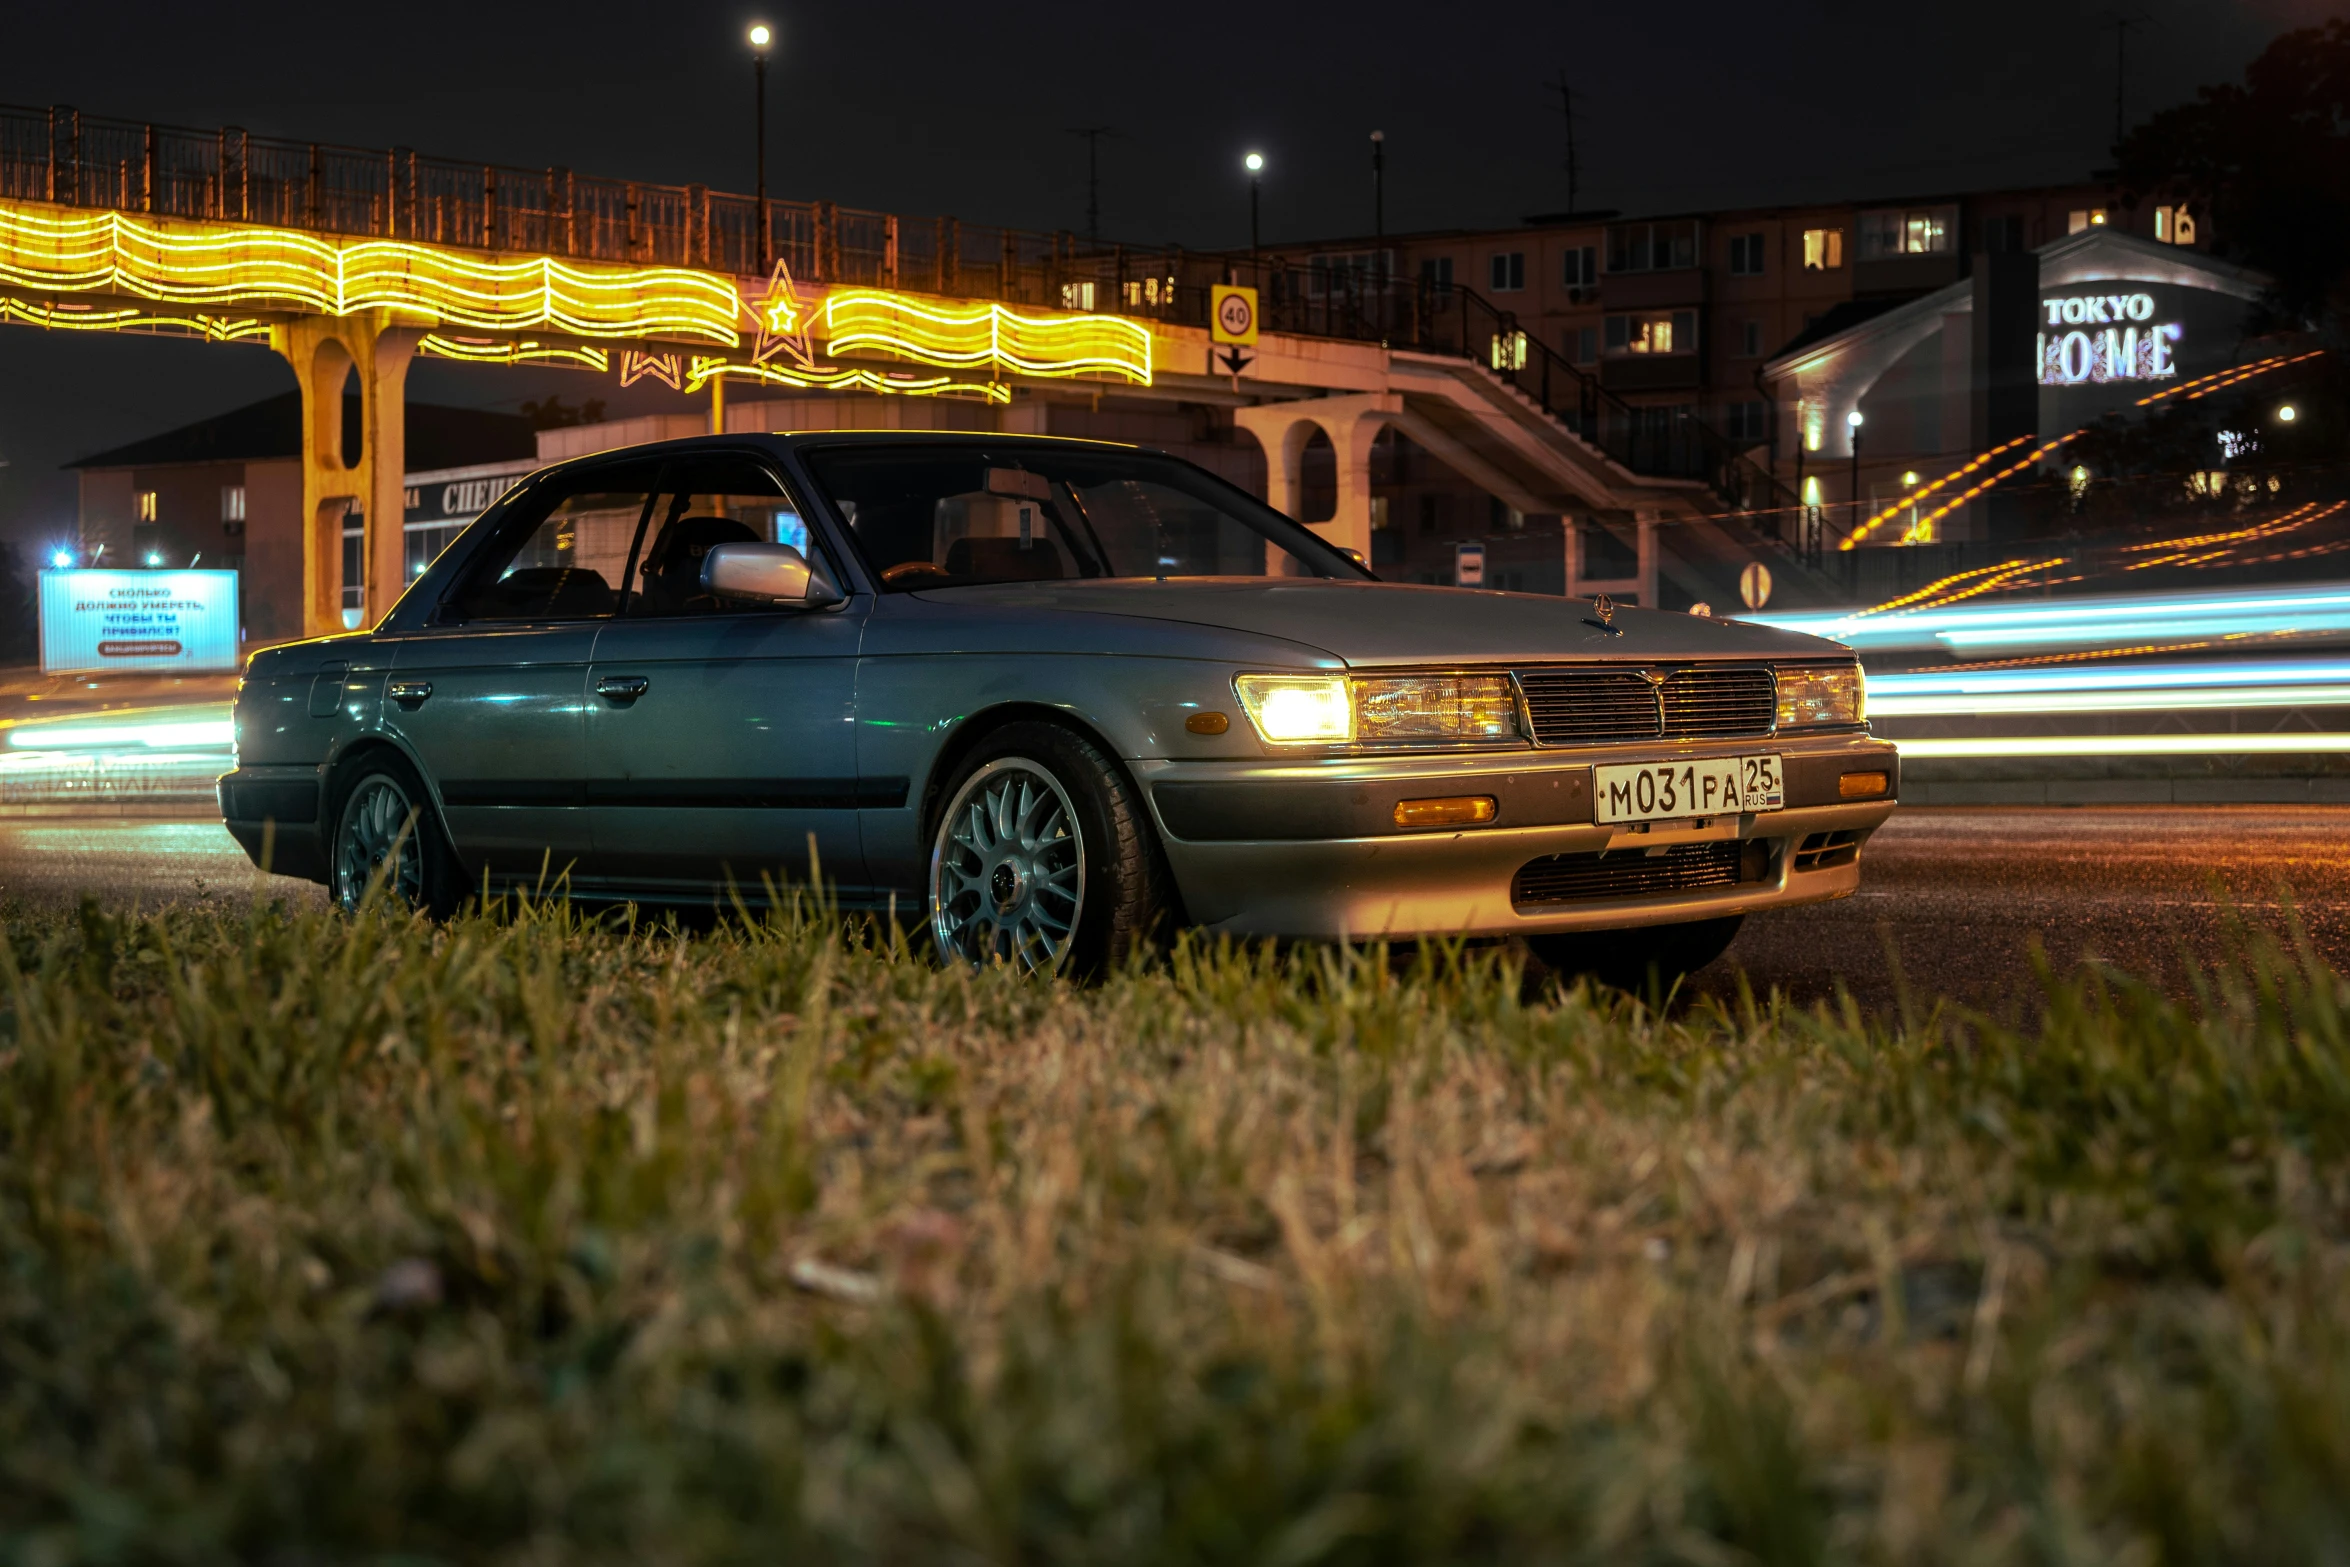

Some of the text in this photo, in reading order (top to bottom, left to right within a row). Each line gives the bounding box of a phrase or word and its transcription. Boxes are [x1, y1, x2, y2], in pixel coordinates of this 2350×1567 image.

[1224, 307, 1247, 325] 40
[2043, 293, 2155, 324] TOKYO
[2037, 323, 2182, 384] OME
[109, 587, 171, 598] СКОЛЬКО
[75, 600, 137, 612] ДОЛЖНО
[105, 613, 176, 624] ЧТОБЫ ТЫ
[1745, 759, 1773, 793] 25
[1745, 793, 1766, 806] RUS
